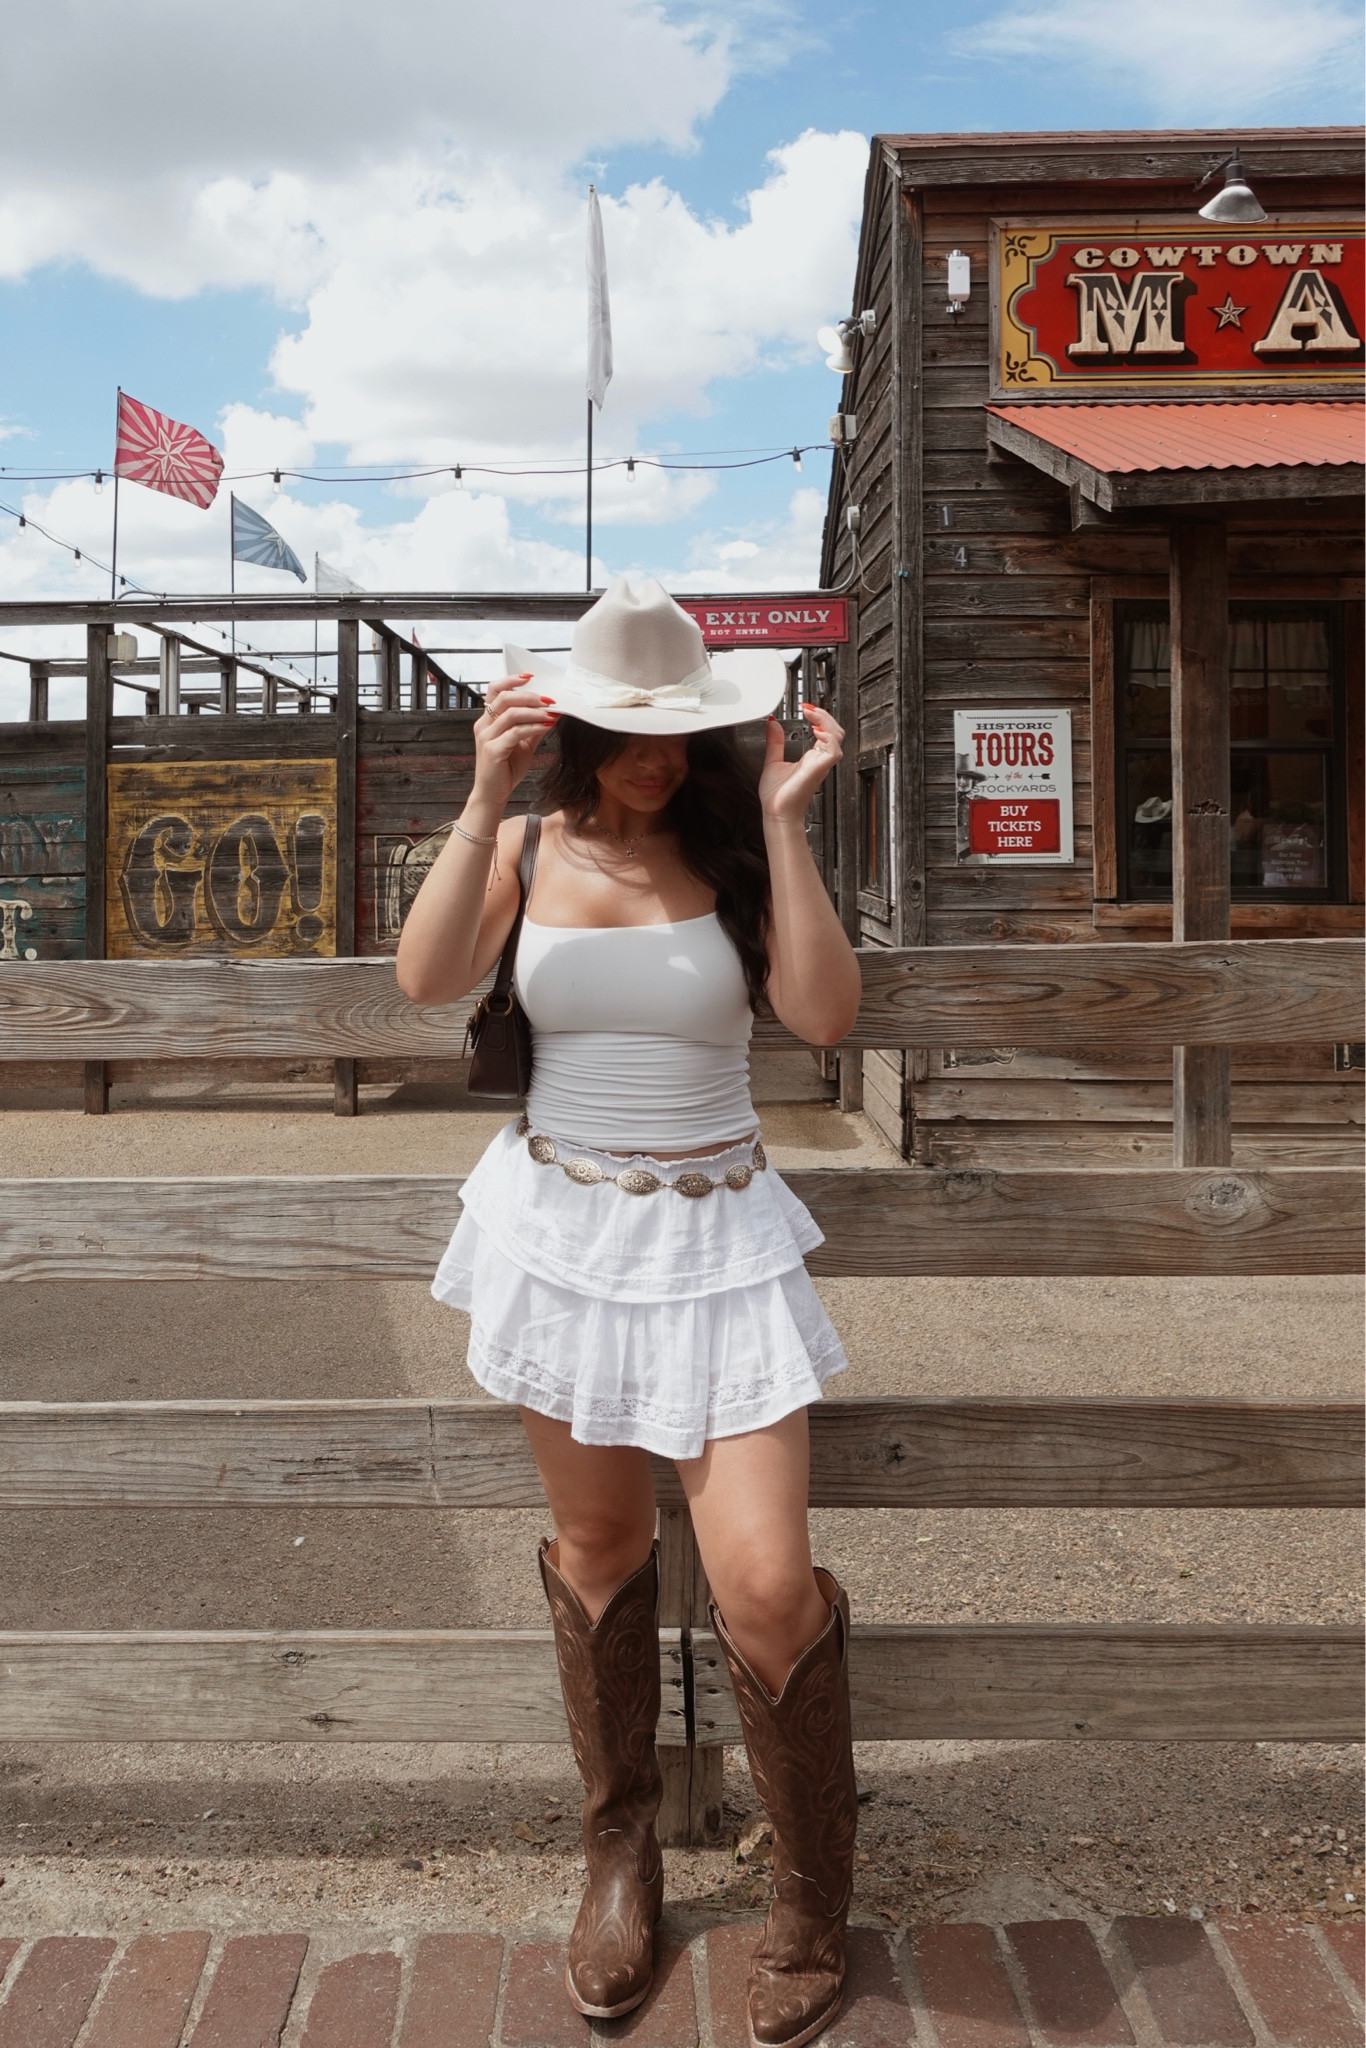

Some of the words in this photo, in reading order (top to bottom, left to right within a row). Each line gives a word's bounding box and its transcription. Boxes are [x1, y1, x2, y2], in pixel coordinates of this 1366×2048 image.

[1071, 244, 1344, 268] COWTOWN
[954, 546, 967, 567] 4
[705, 611, 760, 626] EXIT
[768, 609, 831, 624] ONLY
[735, 628, 769, 636] ENTER
[976, 722, 1053, 730] HISTORIC
[971, 732, 1054, 767] TOURS
[972, 784, 1056, 793] STOCKYARDS
[1000, 805, 1028, 817] BUY
[988, 820, 1042, 832] TICKETS
[997, 836, 1033, 847] HERE
[118, 812, 327, 946] GO!
